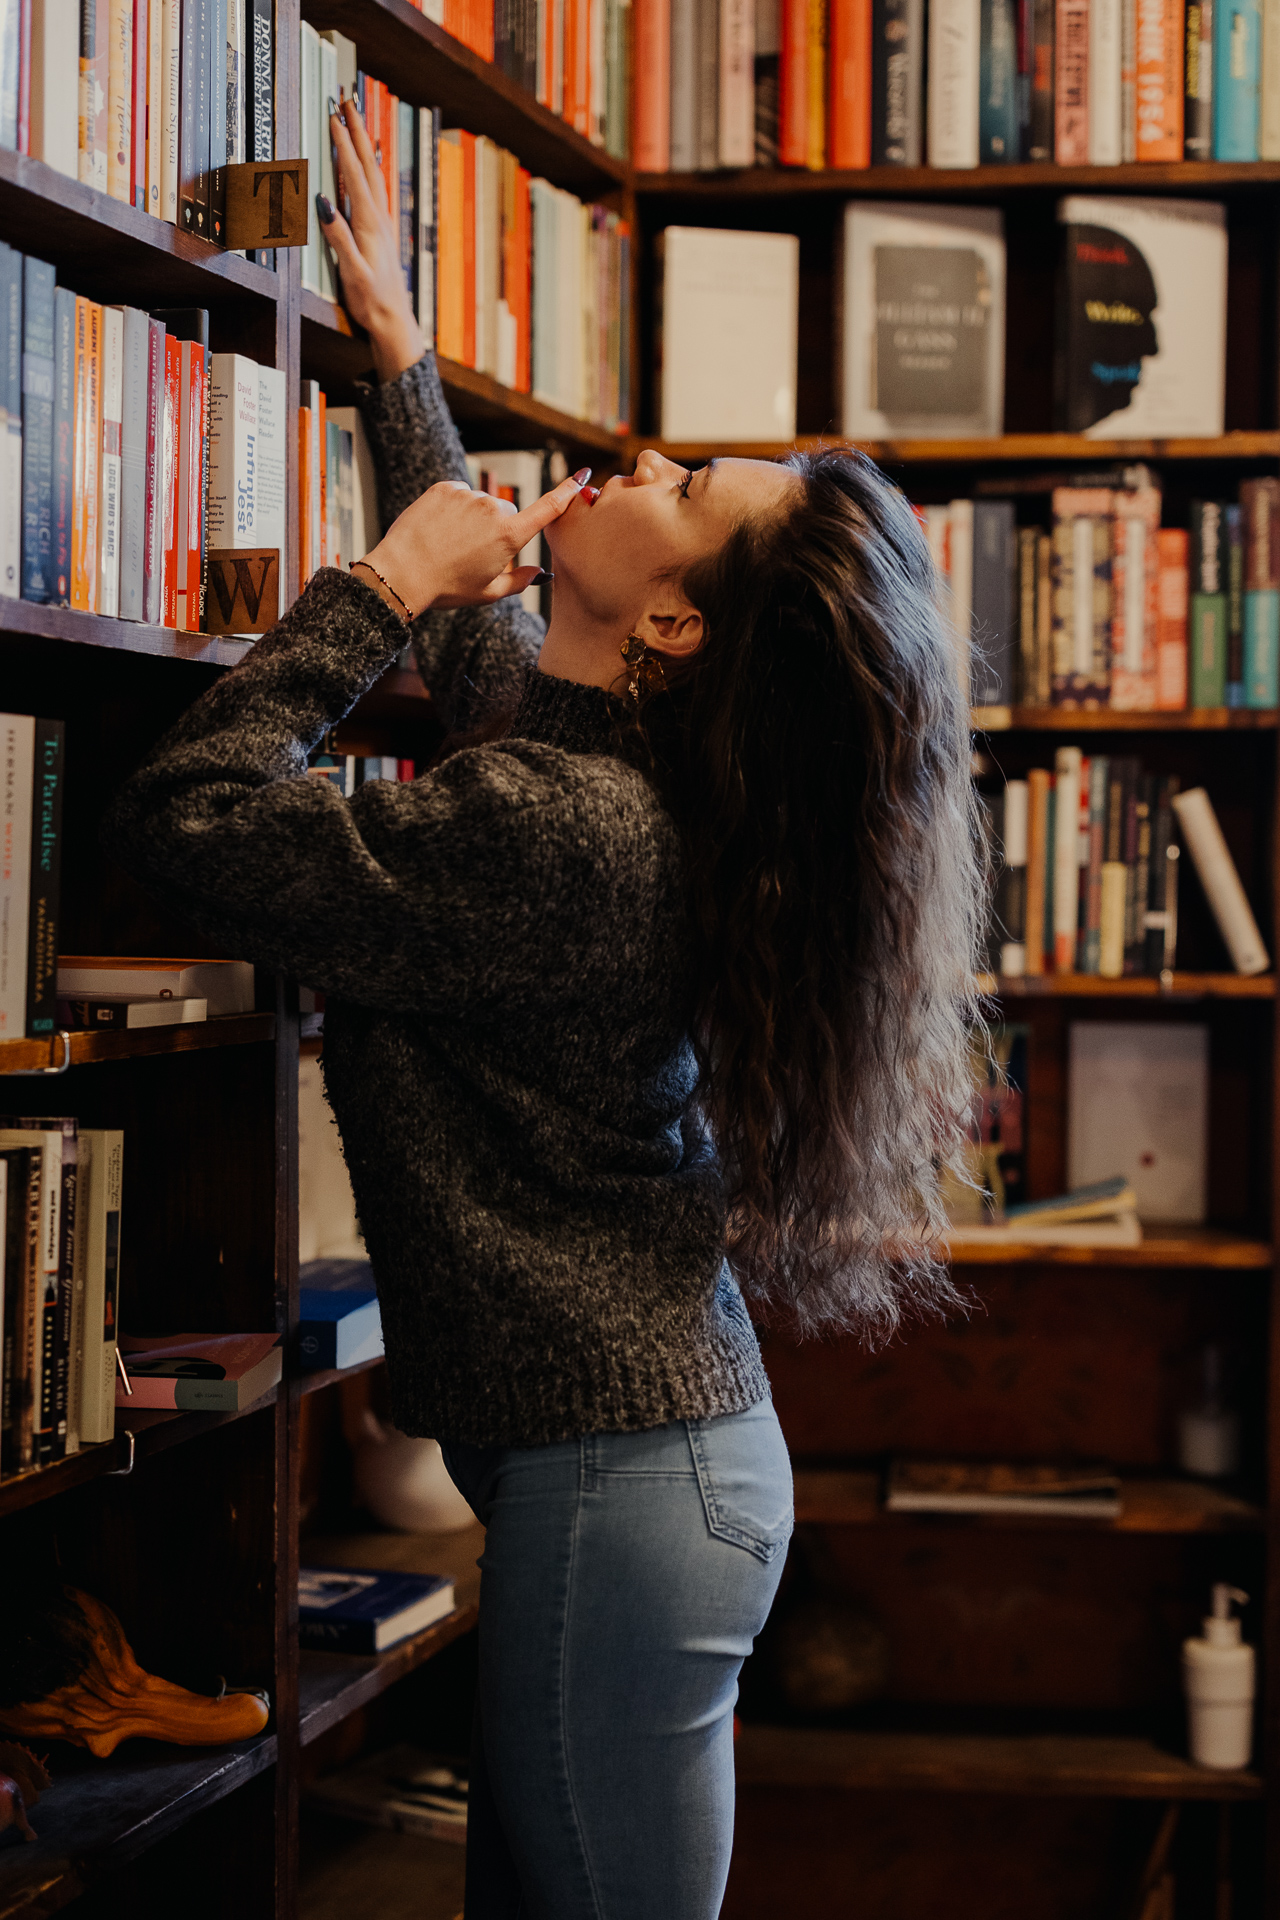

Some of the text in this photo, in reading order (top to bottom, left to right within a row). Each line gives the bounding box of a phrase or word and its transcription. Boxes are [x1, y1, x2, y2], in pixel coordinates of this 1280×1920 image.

[165, 48, 179, 164] William Styron
[254, 13, 262, 162] THE SECRET HISTORY
[261, 18, 272, 162] DONNA TARTT
[253, 170, 299, 239] T
[61, 314, 70, 345] JOHN
[61, 347, 69, 371] VAN
[61, 372, 69, 385] DE
[258, 380, 268, 390] The
[237, 382, 252, 396] David
[243, 397, 257, 411] Foster
[258, 392, 272, 404] David
[258, 405, 273, 415] Foster
[239, 409, 257, 425] Wallace
[258, 416, 276, 428] Wallace
[258, 428, 274, 439] Reader
[25, 395, 39, 568] RABBIT AT REST
[38, 401, 51, 555] RABBIT IS RICH
[247, 434, 256, 527] Infinite
[87, 497, 95, 516] THE
[107, 463, 116, 558] LOOK WHO'S BACK
[131, 484, 141, 573] Creation
[237, 479, 248, 534] Jest
[57, 546, 67, 567] Fly
[59, 532, 67, 545] to
[199, 584, 207, 617] PICADOR
[211, 556, 276, 625] W
[40, 735, 59, 871] To Paradise
[34, 897, 47, 1004] YANAGIHARA
[45, 921, 55, 978] HANYA
[29, 1155, 42, 1245] EMBERS
[61, 1279, 73, 1341] Afternoon
